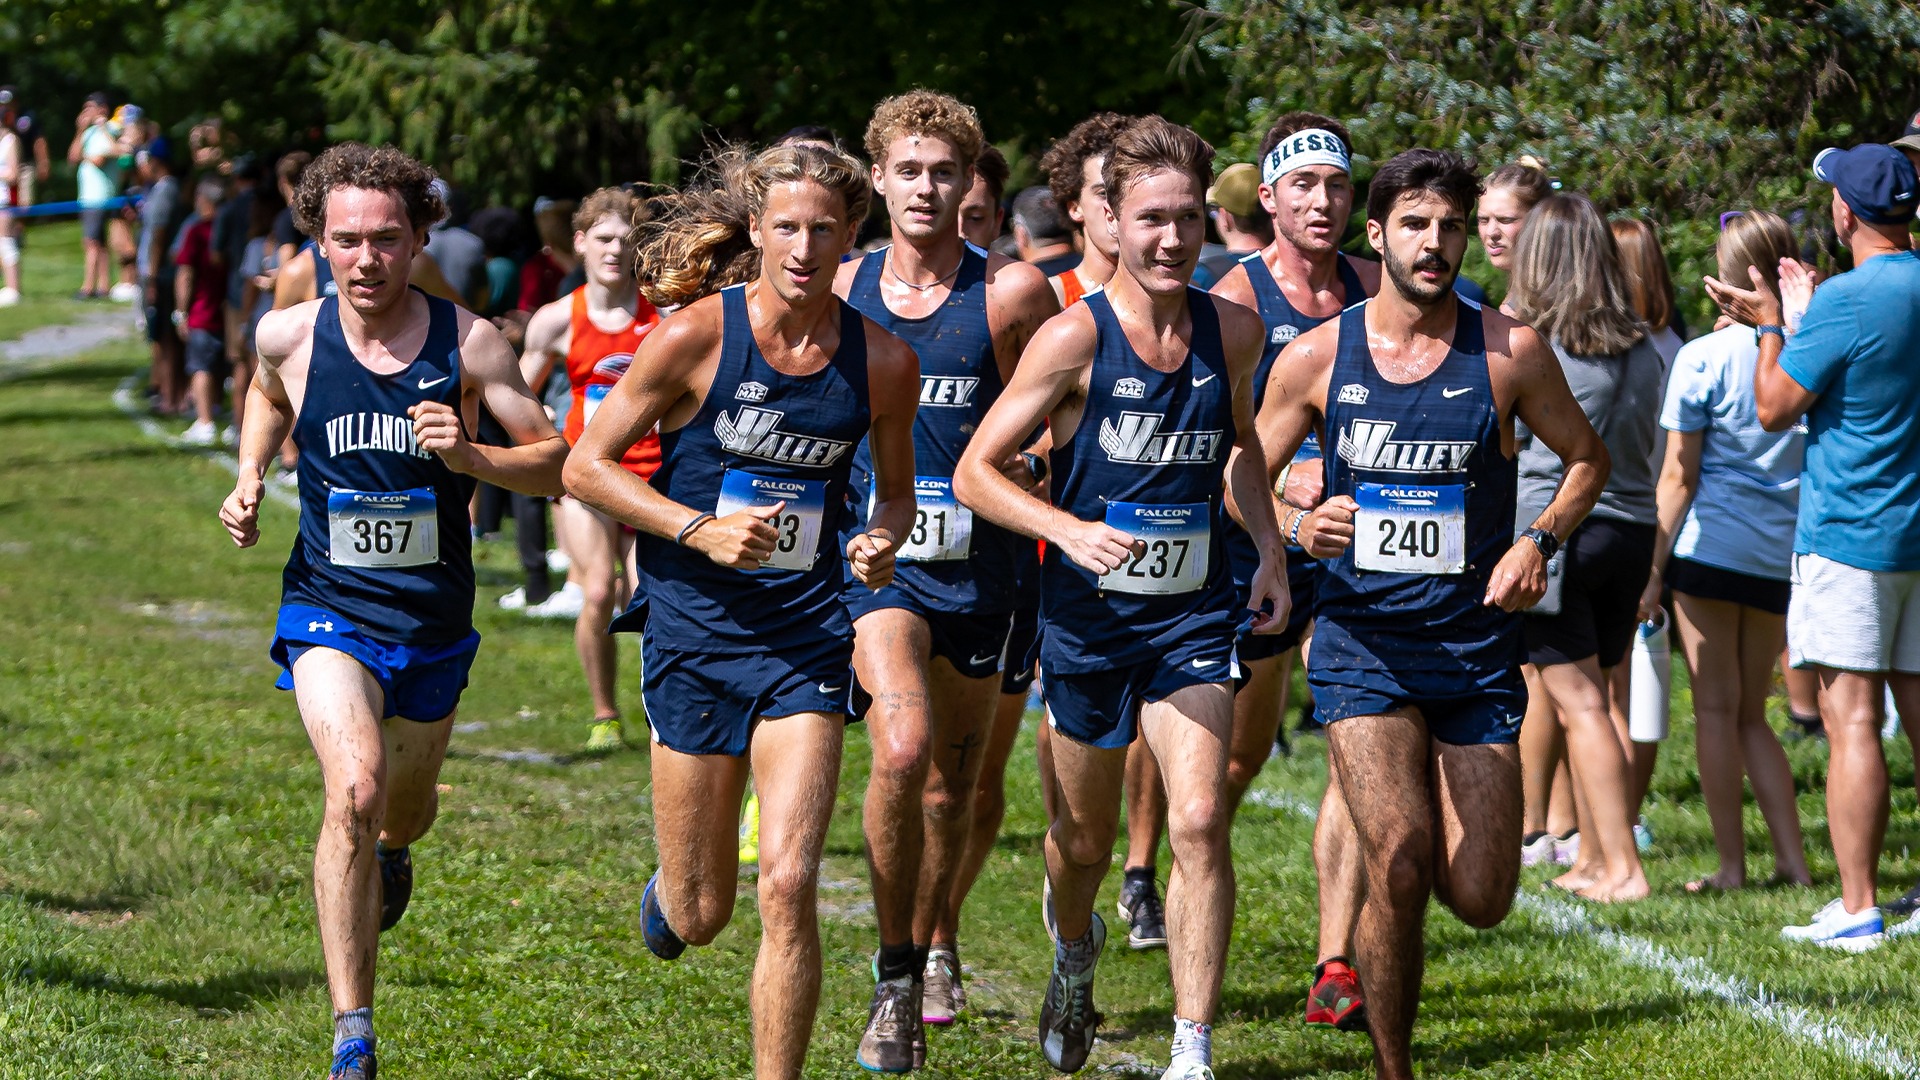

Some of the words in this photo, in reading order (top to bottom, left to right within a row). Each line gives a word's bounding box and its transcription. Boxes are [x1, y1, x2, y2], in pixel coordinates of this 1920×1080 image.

[738, 389, 766, 401] MAC
[1115, 385, 1143, 397] MAC
[722, 404, 852, 468] VALLEY
[1108, 411, 1223, 465] VALLEY
[1348, 418, 1477, 473] VALLEY
[751, 479, 806, 492] FALCON
[1380, 489, 1438, 498] FALCON
[353, 494, 410, 503] FALCON
[1135, 508, 1191, 517] FALCON
[353, 519, 413, 554] 367
[1378, 519, 1440, 558] 240
[1127, 539, 1190, 579] 237
